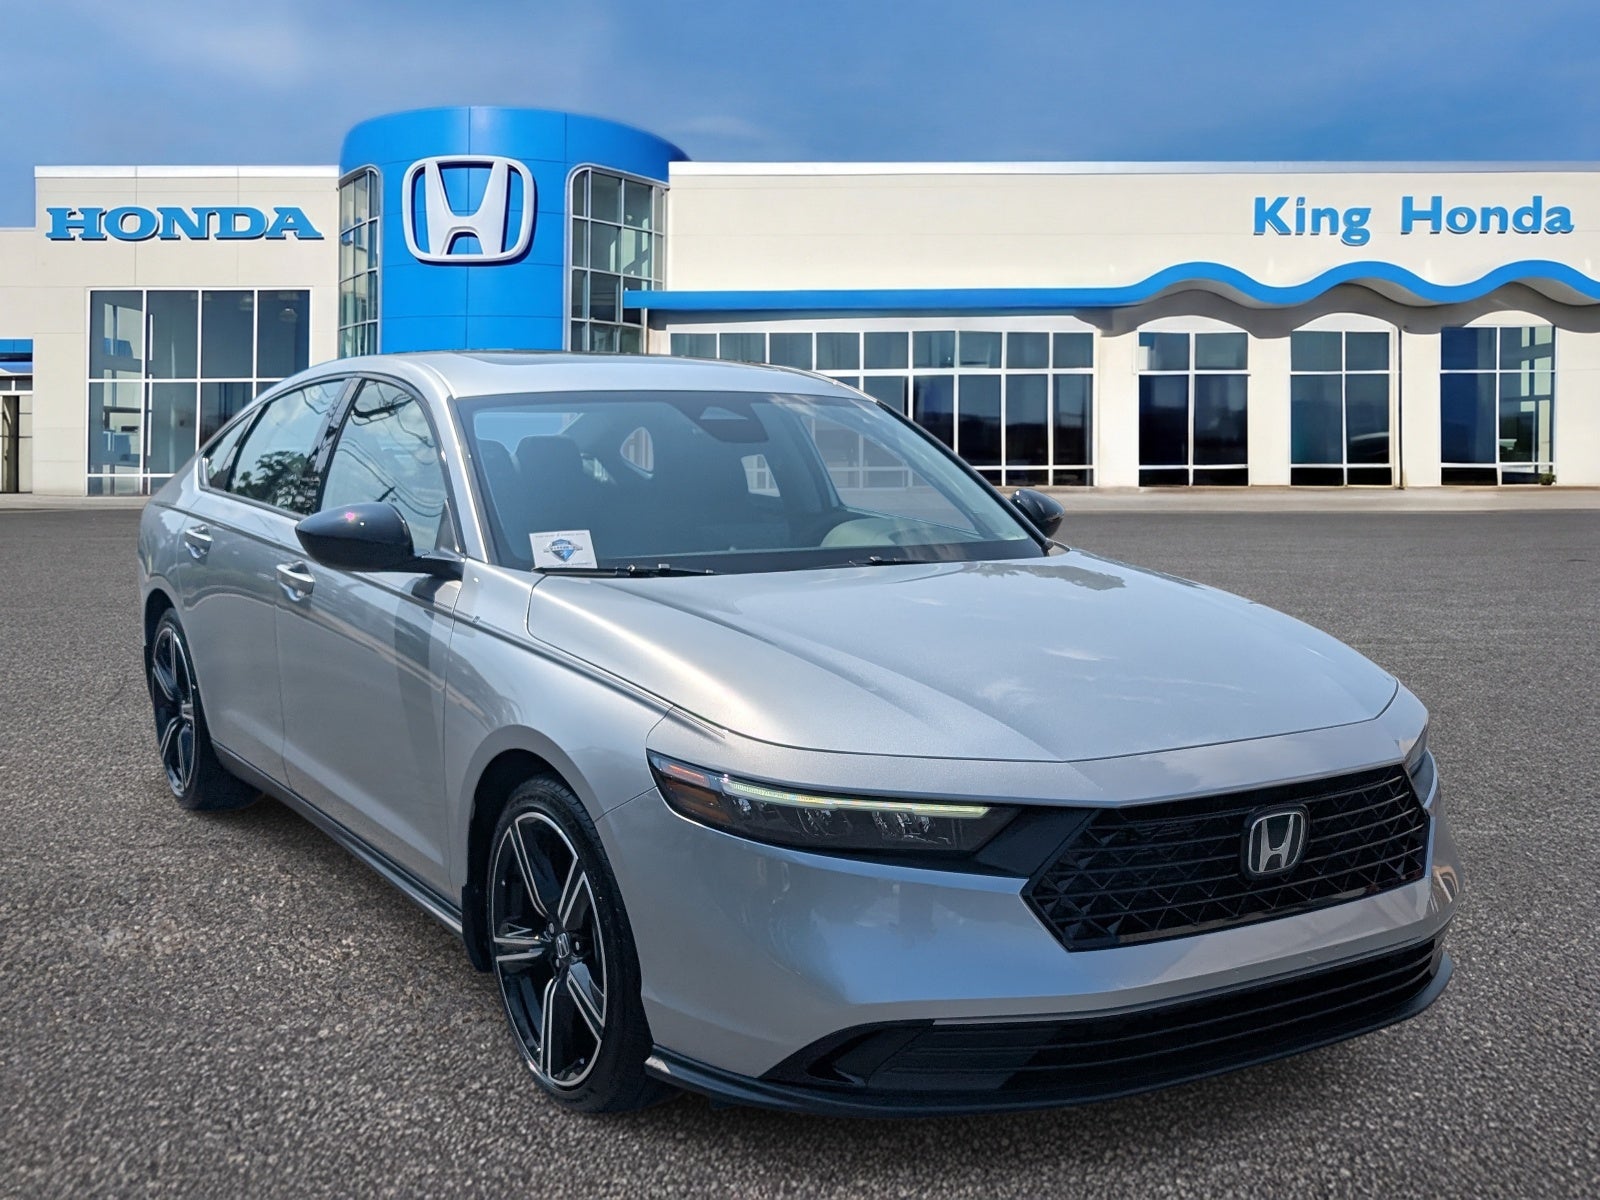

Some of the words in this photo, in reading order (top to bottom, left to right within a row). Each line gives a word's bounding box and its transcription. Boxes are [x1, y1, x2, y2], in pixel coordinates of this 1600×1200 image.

[46, 206, 325, 241] HONDA
[1253, 196, 1372, 246] King
[1400, 195, 1575, 235] Honda
